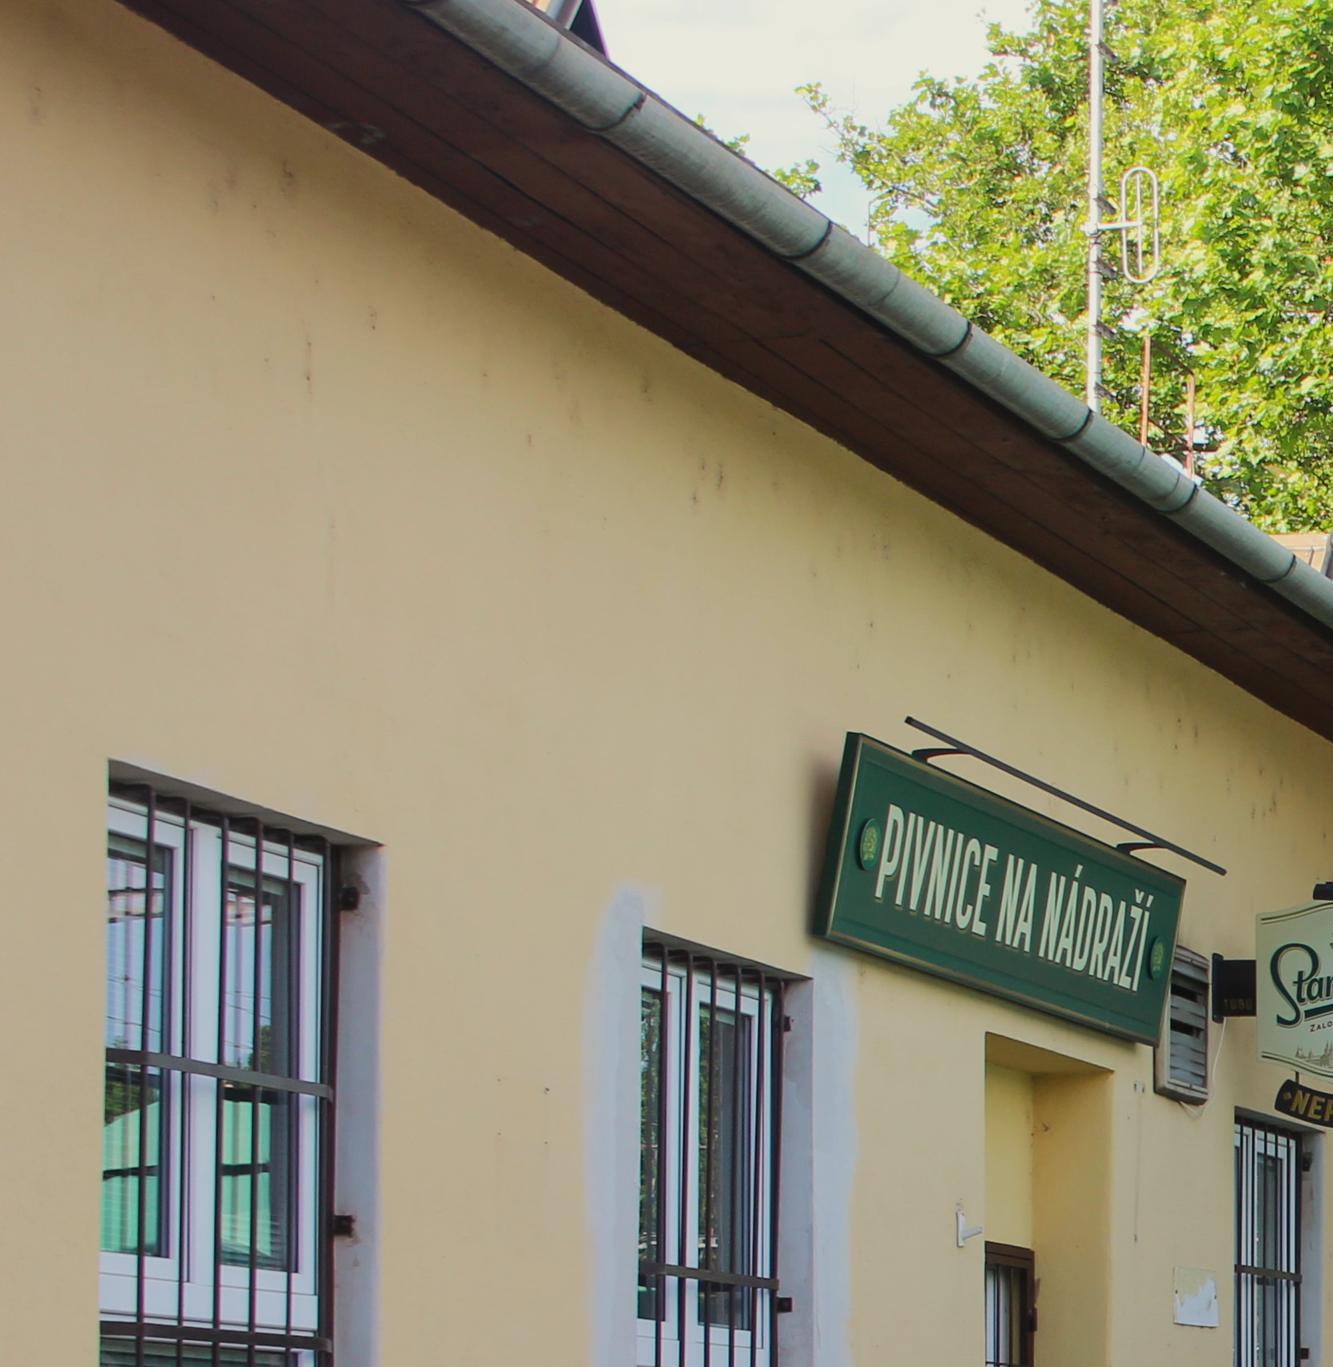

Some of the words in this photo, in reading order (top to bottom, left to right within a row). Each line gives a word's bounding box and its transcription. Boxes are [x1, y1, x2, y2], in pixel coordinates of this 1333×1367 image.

[874, 803, 998, 936] PIVNICE
[995, 854, 1038, 953] NA
[1038, 863, 1154, 992] NÁDRAŽÍ
